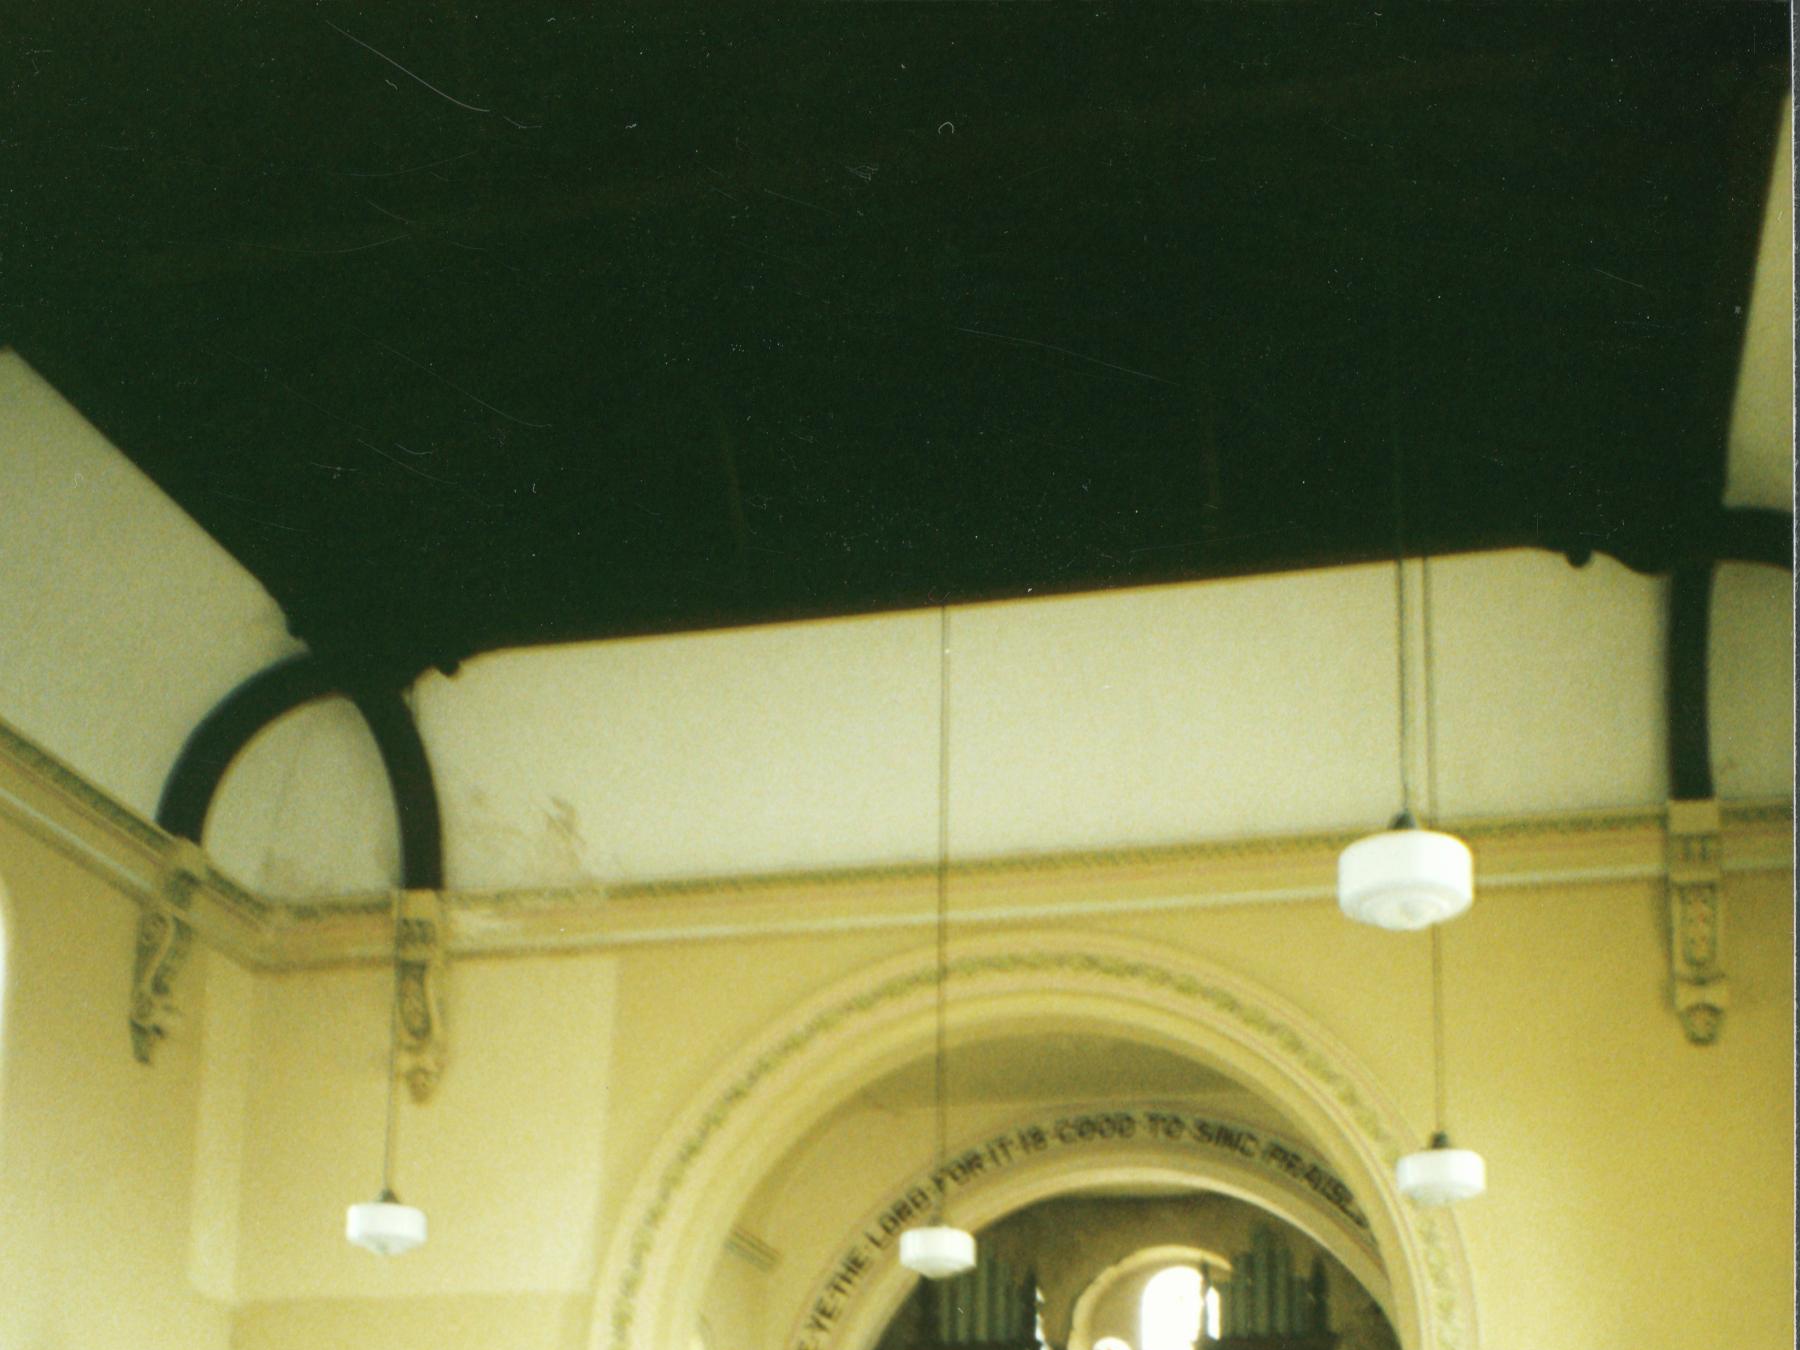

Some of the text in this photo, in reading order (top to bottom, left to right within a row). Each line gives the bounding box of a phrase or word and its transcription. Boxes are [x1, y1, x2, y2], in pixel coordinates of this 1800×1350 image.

[806, 1296, 838, 1332] YE
[827, 1248, 867, 1295] THE
[864, 1187, 929, 1248] LORD
[930, 1151, 984, 1192] FOR
